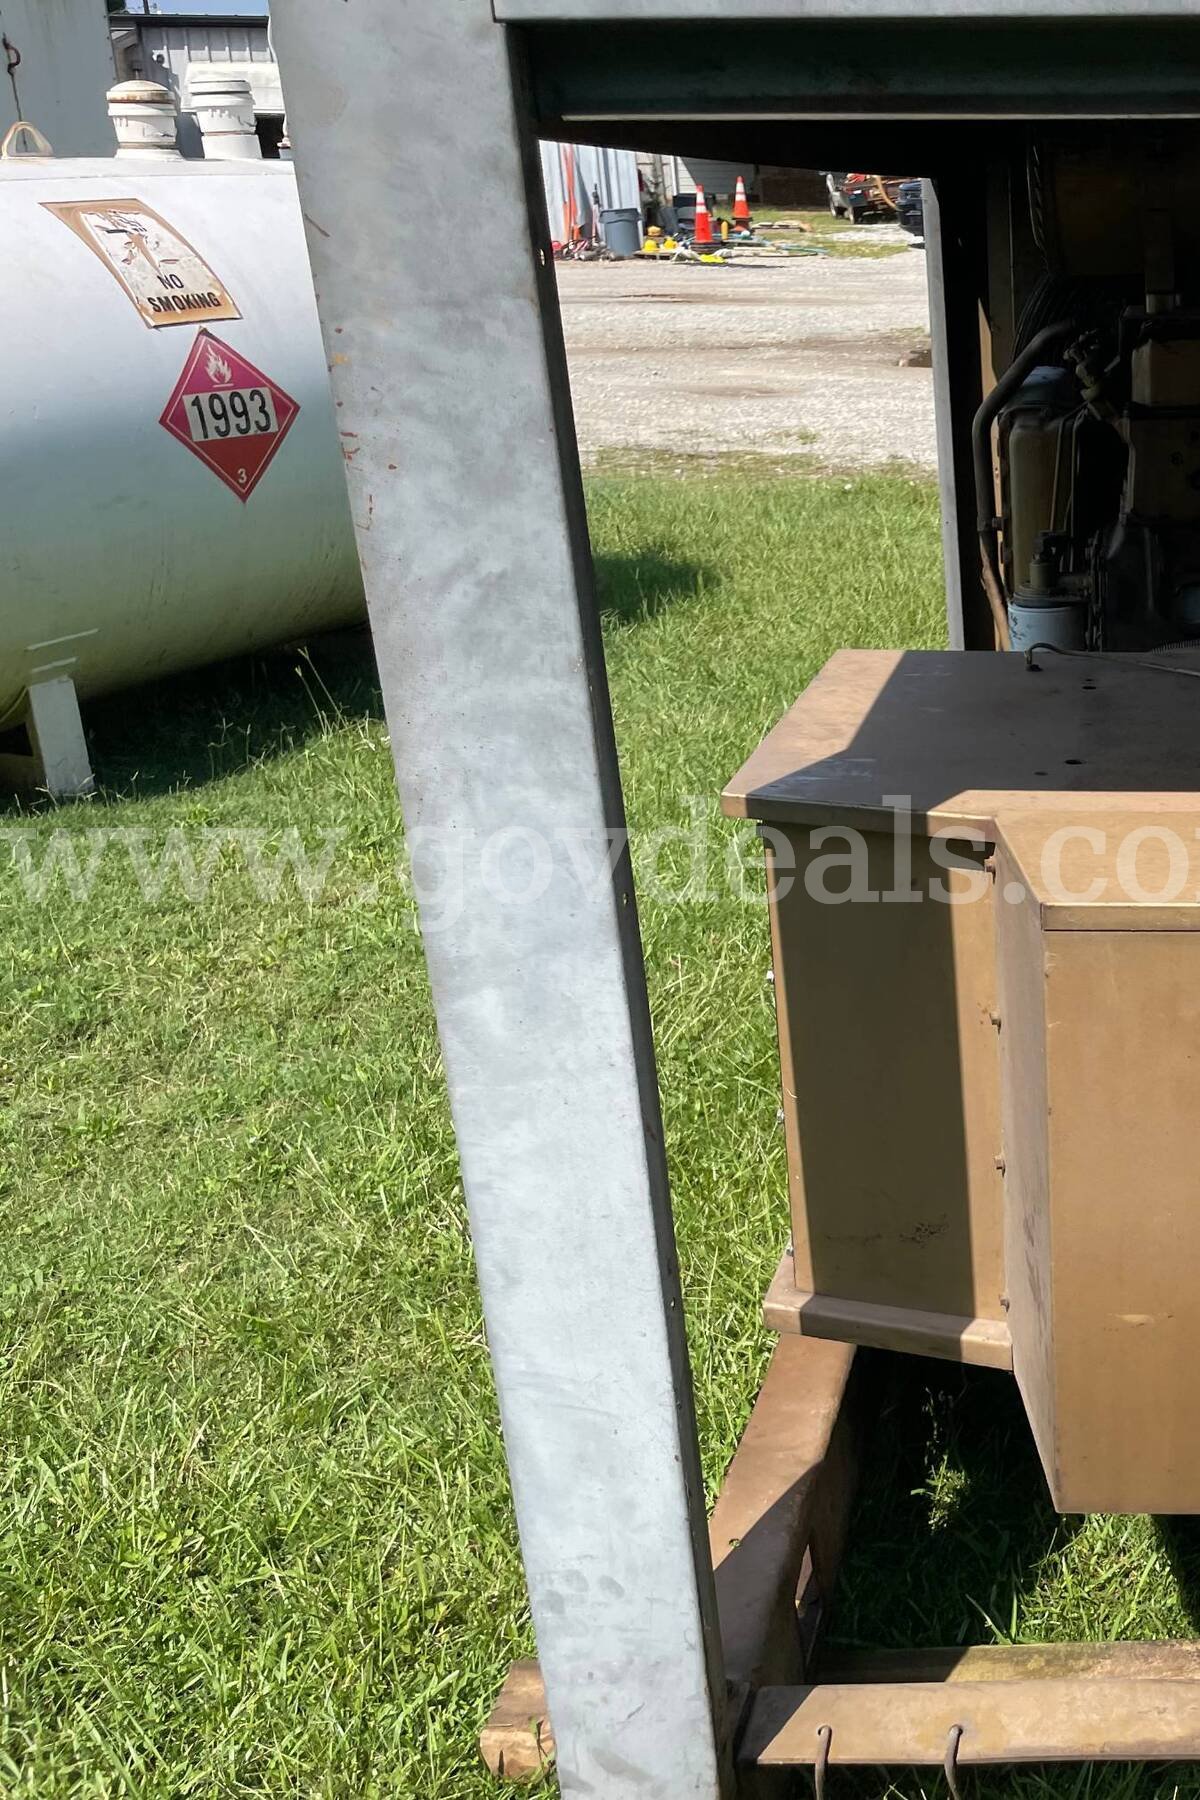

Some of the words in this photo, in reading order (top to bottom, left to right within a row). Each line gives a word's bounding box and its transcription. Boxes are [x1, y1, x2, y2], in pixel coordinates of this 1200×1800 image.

[156, 273, 184, 290] NO
[147, 292, 222, 314] SMOKING
[191, 389, 271, 439] 1993
[237, 468, 248, 483] 3
